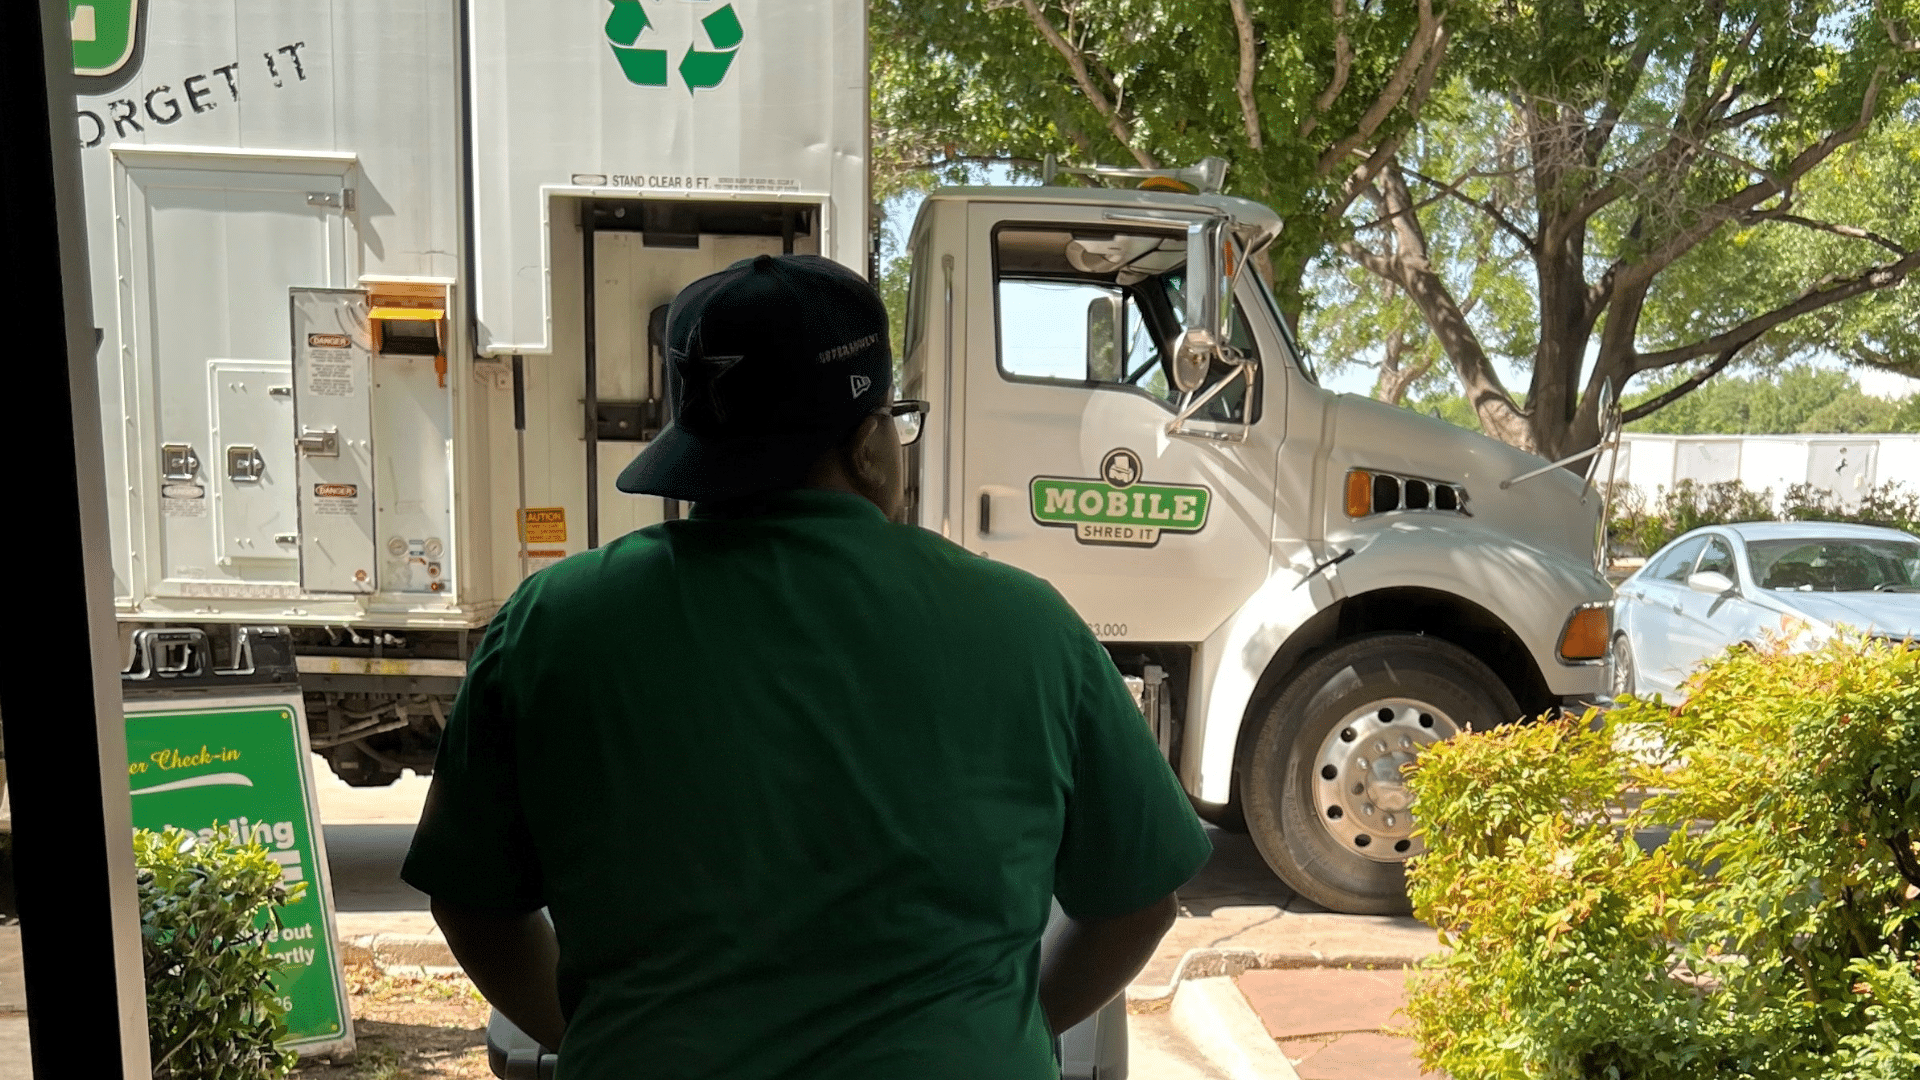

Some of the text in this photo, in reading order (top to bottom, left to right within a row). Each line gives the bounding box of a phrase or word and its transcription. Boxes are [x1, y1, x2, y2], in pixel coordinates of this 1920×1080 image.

[612, 175, 645, 188] STAND
[648, 176, 682, 189] CLEAR
[685, 176, 693, 189] 8
[1044, 488, 1198, 521] MOBILE
[1084, 525, 1154, 540] SHRED IT
[150, 744, 241, 770] Check-in
[285, 922, 314, 942] out
